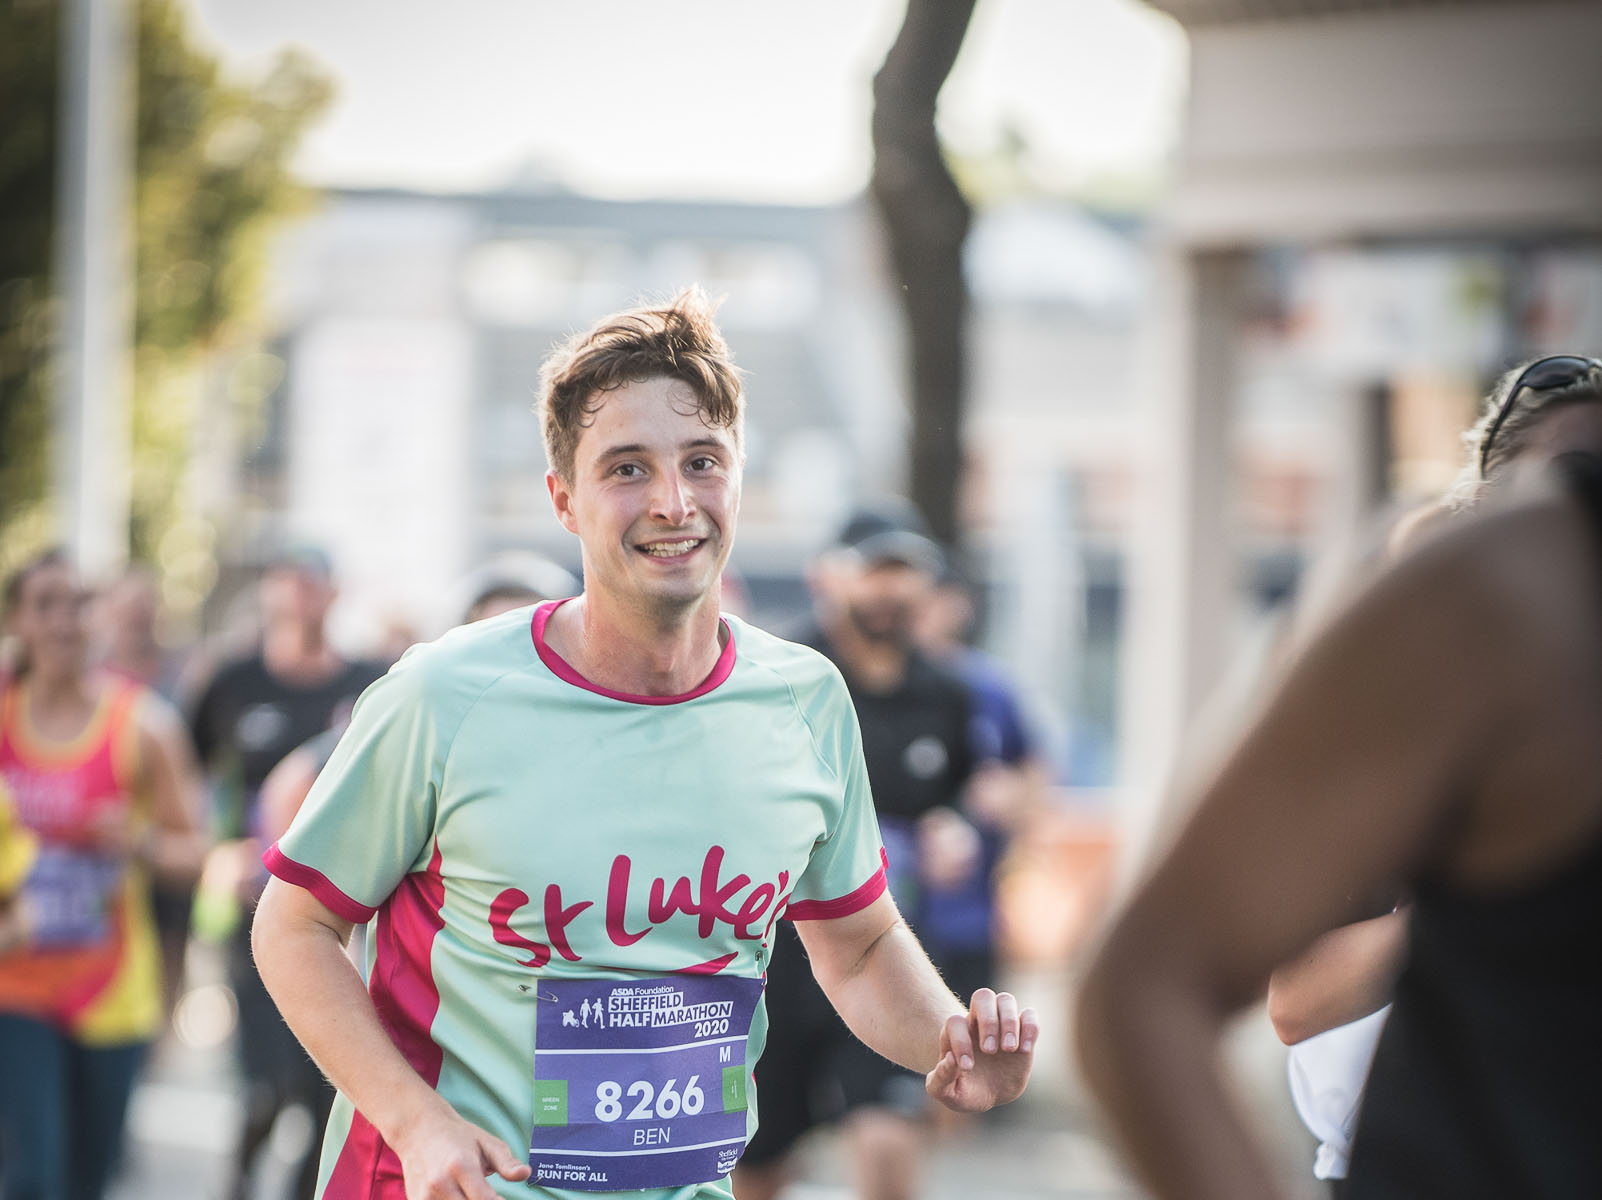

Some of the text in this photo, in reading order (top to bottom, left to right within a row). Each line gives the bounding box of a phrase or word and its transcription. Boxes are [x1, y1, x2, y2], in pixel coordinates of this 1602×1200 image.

[488, 883, 594, 968] St
[611, 985, 674, 996] ASDA Foundation
[609, 993, 683, 1012] SHEFFIELD
[609, 1002, 732, 1028] HALF MARATHON
[694, 1018, 729, 1038] 2020
[719, 1045, 731, 1063] M
[594, 1075, 705, 1123] 8266
[633, 1126, 671, 1146] BEN
[537, 1169, 609, 1182] RUN FOR ALL
[555, 1163, 591, 1171] Tomlinson's
